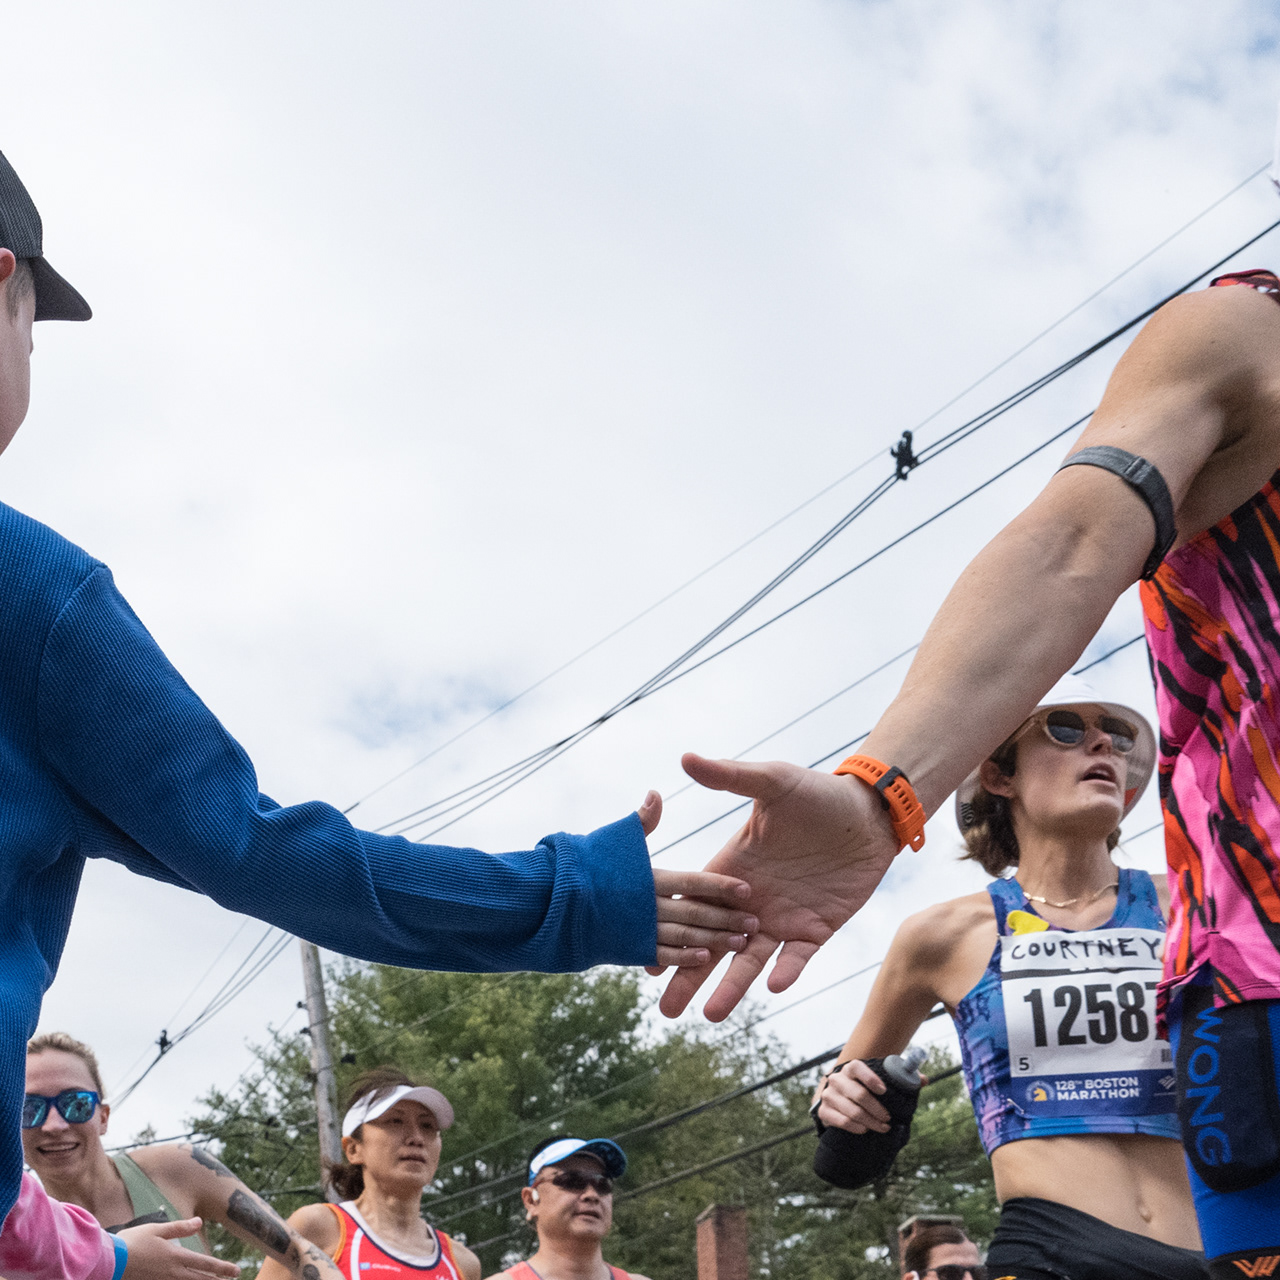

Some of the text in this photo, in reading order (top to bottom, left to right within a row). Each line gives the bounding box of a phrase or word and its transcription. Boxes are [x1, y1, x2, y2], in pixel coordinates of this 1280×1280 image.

[1011, 937, 1161, 960] COURTNEY
[1019, 1057, 1029, 1071] 5
[1084, 1077, 1138, 1089] BOSTON
[1185, 1006, 1232, 1166] WONG
[1057, 1088, 1140, 1101] MARATHON
